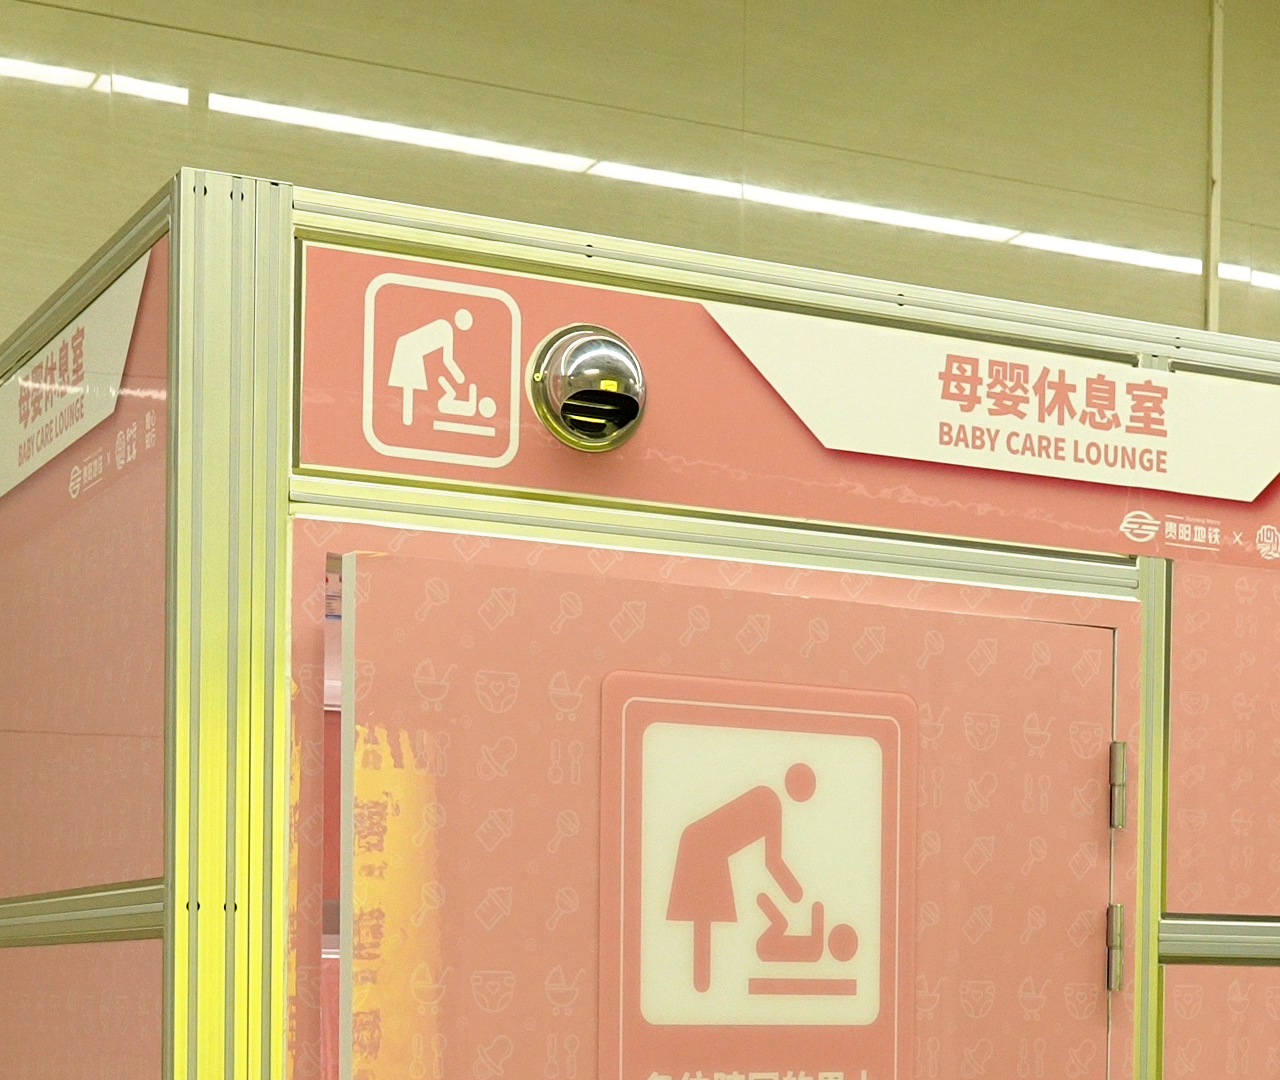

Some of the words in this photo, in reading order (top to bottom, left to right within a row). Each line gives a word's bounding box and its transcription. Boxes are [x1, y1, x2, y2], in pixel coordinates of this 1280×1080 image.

[938, 354, 1168, 437] 母婴休息室
[938, 422, 1000, 452] BABY
[1006, 431, 1066, 461] CARE
[1073, 440, 1168, 473] LOUNGE
[1165, 521, 1221, 545] 贵阳地铁
